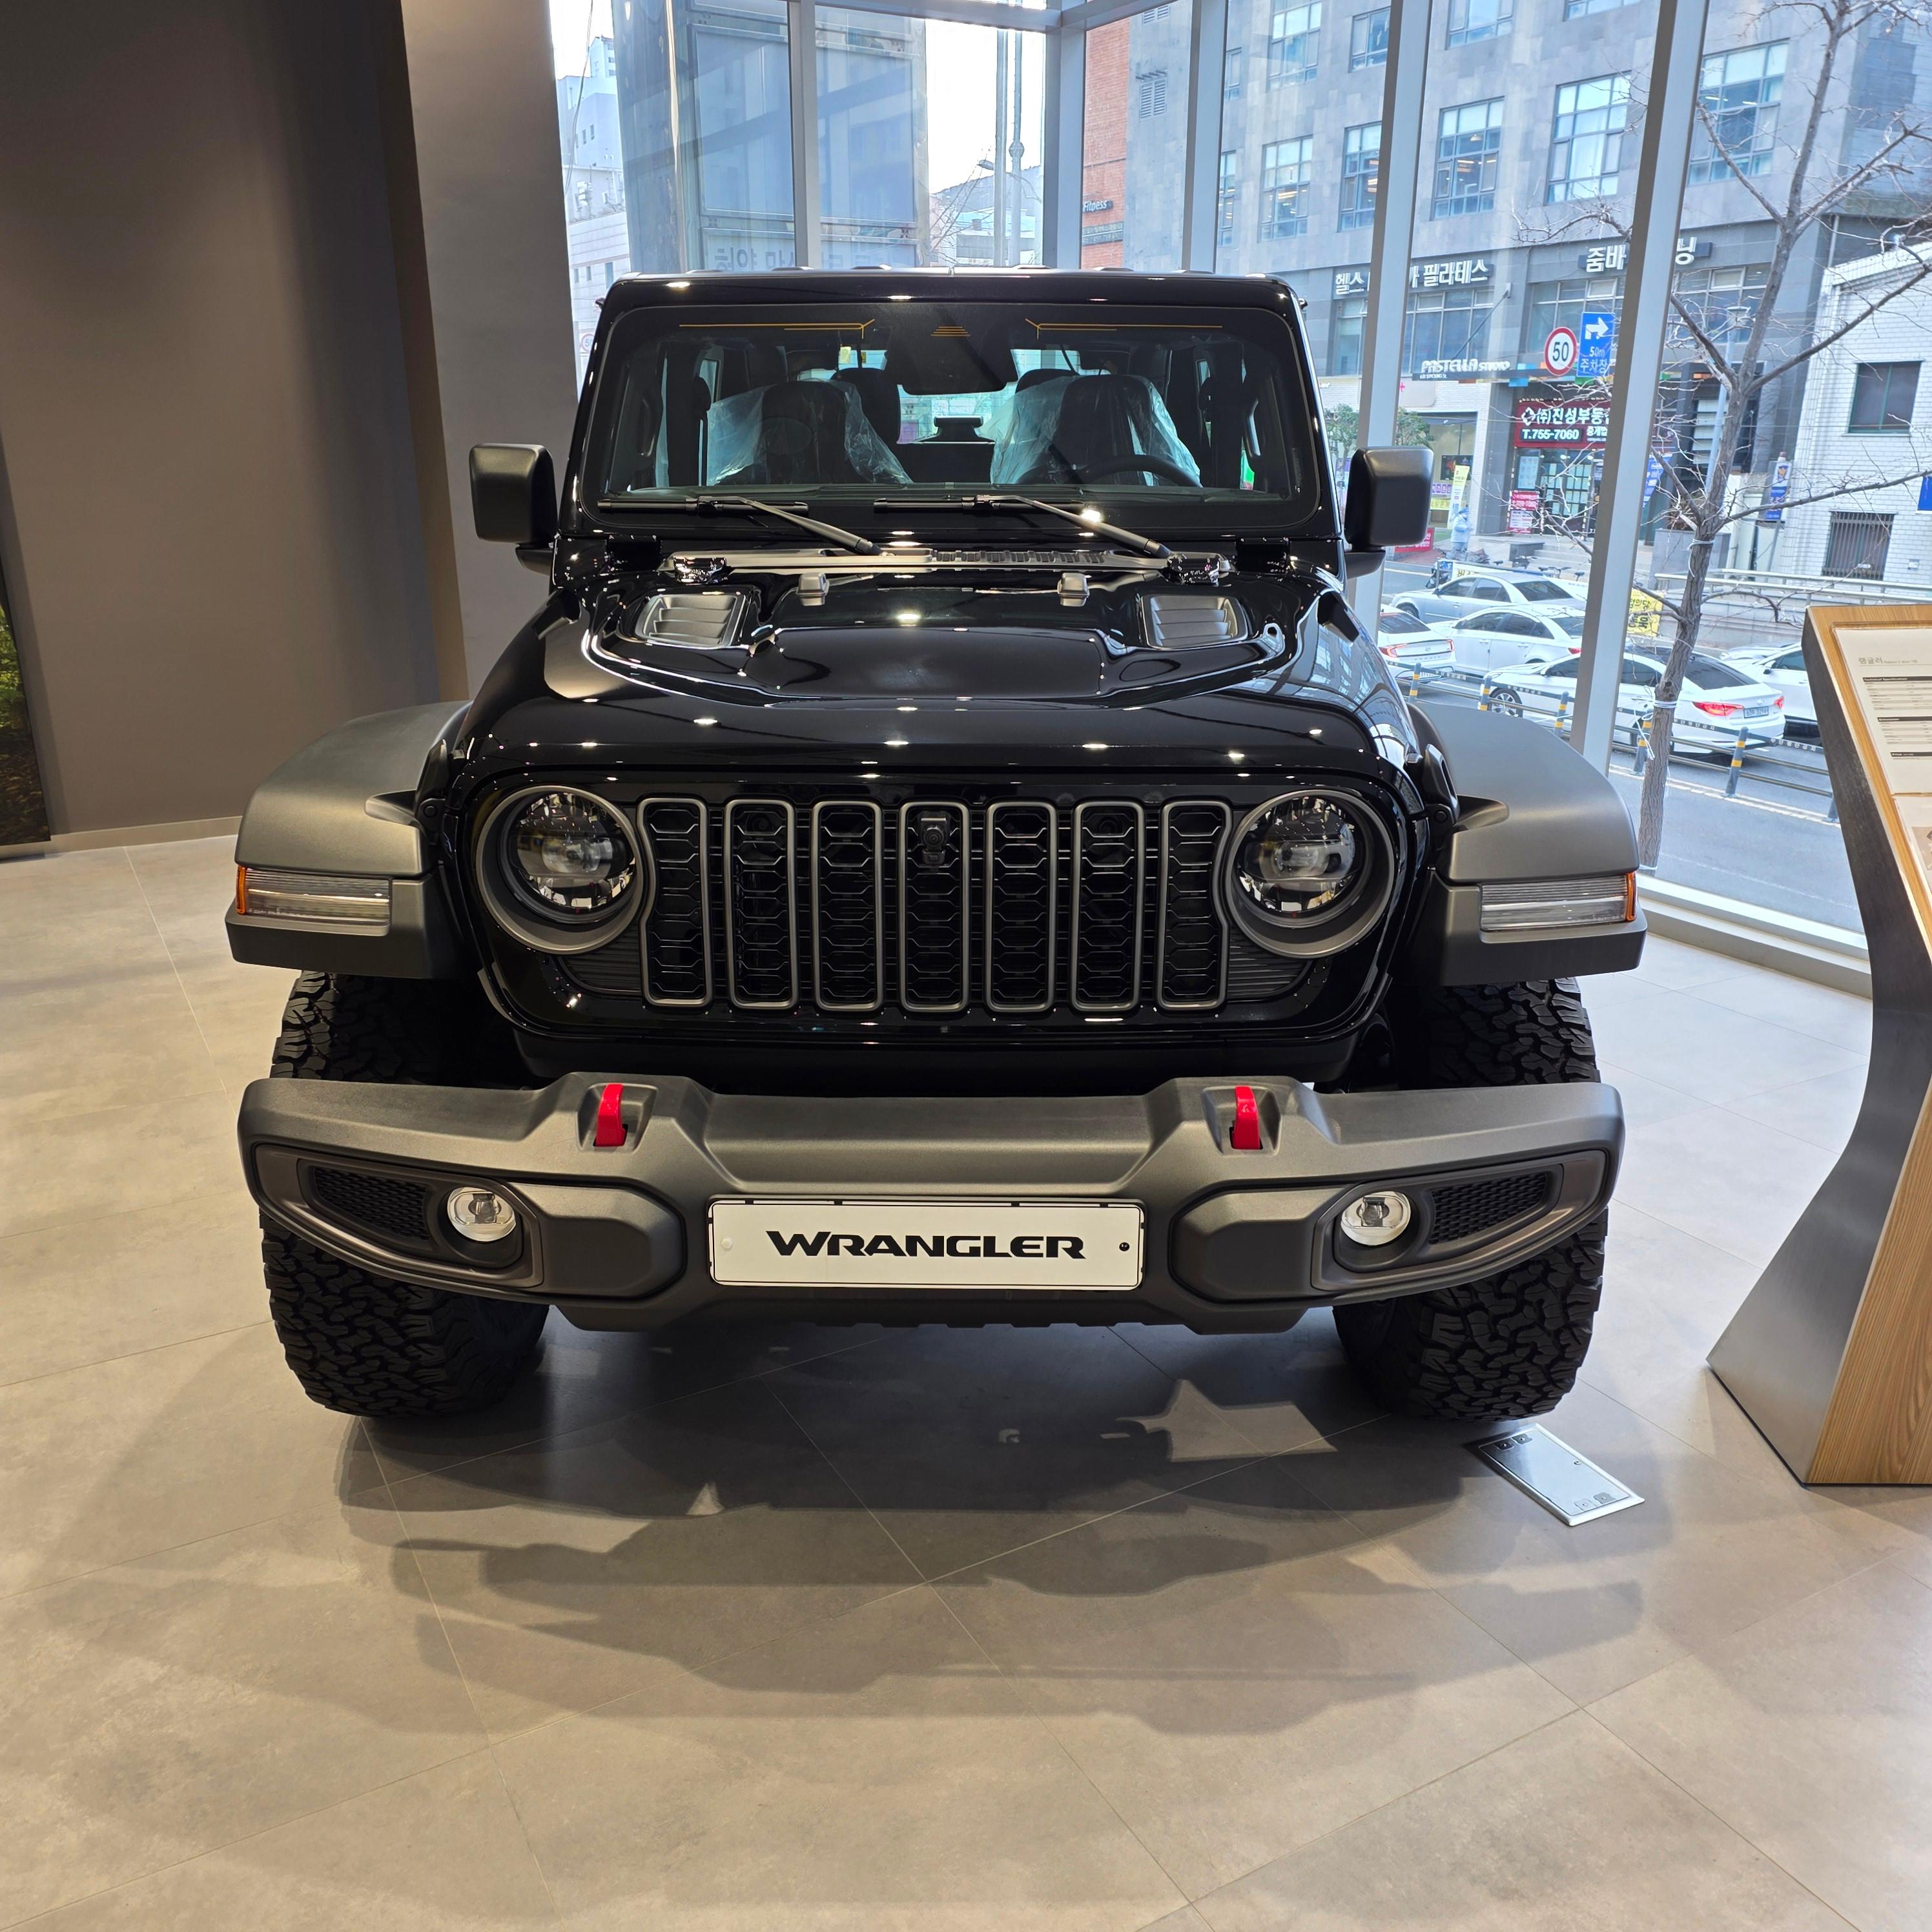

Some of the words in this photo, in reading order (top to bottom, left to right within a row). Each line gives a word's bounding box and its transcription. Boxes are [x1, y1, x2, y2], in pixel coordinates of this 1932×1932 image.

[1586, 244, 1627, 272] 줌바
[1335, 272, 1364, 295] 헬스
[1423, 259, 1488, 287] 필라테스
[1552, 342, 1569, 362] 50
[1589, 346, 1605, 358] 50m
[1580, 358, 1608, 374] 주차장
[1522, 429, 1579, 440] T.755-7060
[766, 1231, 1087, 1259] WRANGLER
